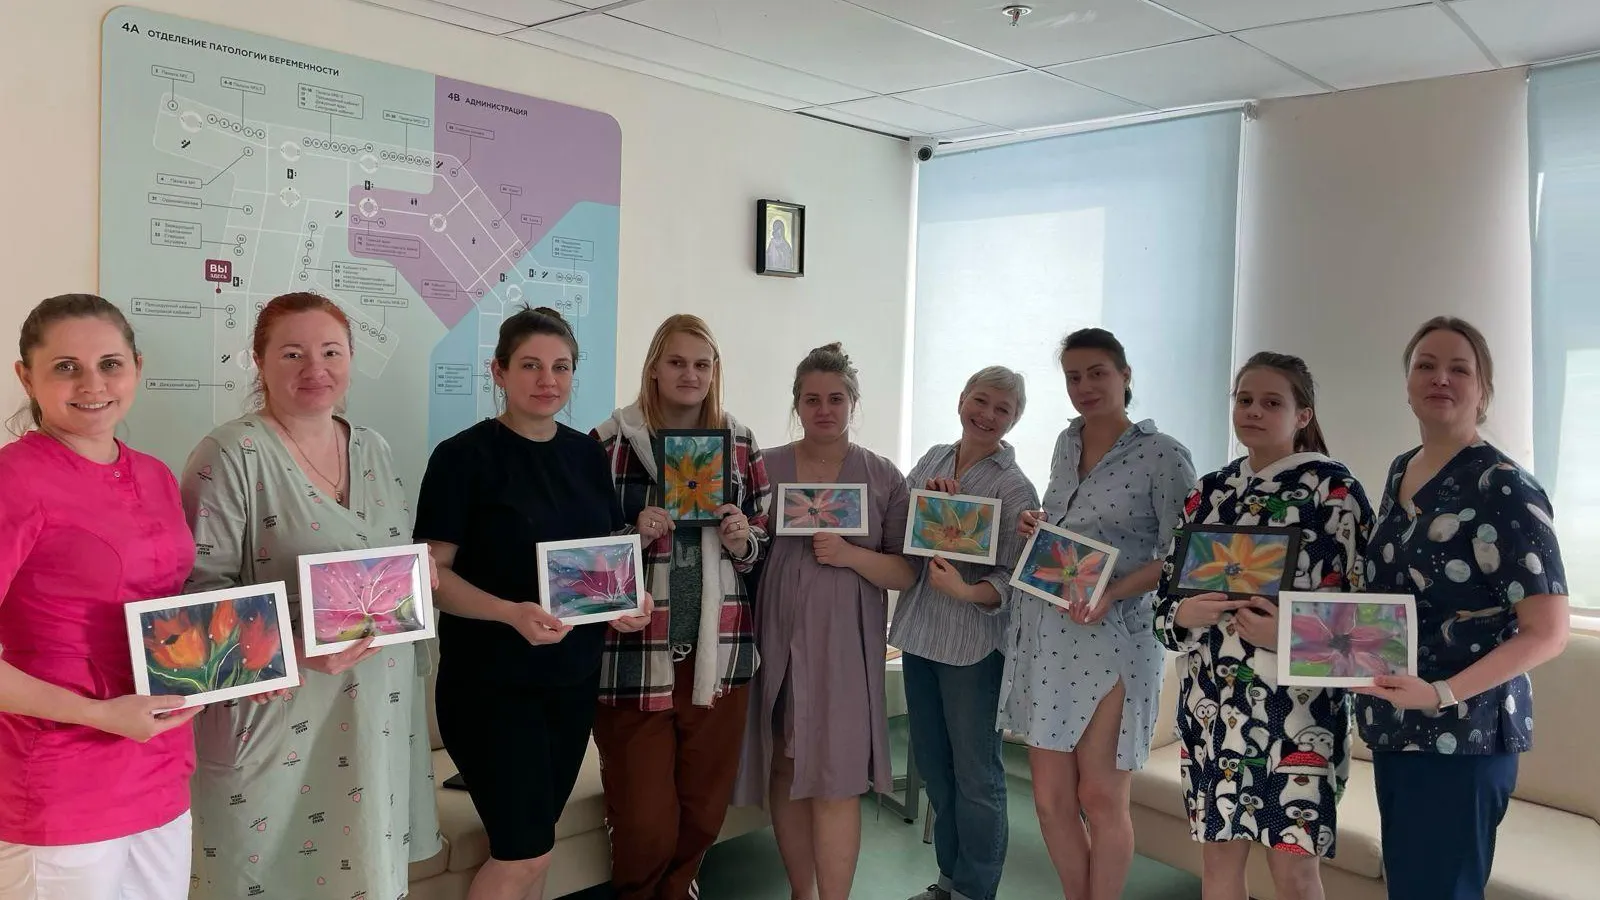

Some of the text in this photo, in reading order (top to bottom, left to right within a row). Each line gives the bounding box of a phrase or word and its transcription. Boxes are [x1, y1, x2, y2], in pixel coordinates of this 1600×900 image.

[122, 22, 340, 76] 4А ОТДЕЛЕНИЕ ПАТОЛОГИИ БЕРЕМЕННОСТИ
[464, 97, 528, 116] АДМИНИСТРАЦИЯ
[210, 264, 228, 274] ВЫ
